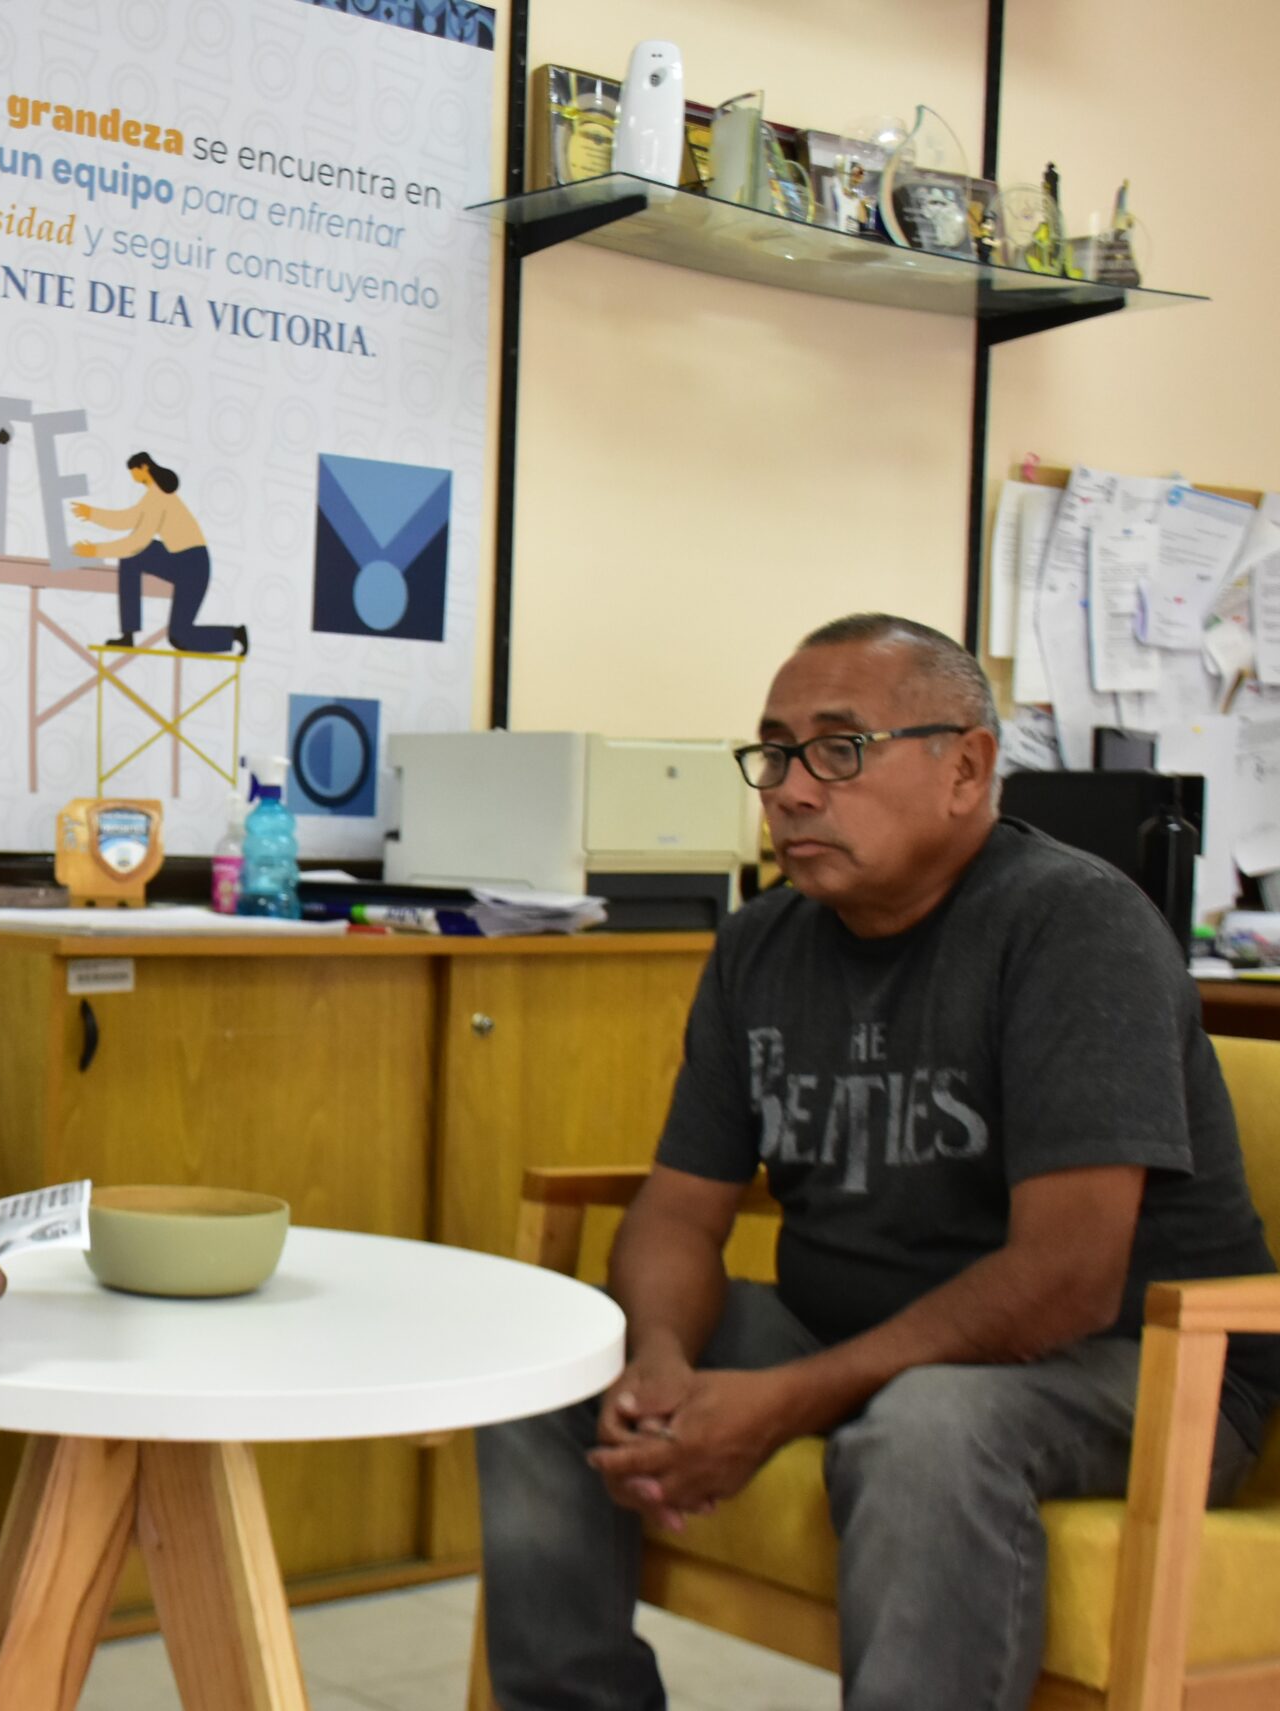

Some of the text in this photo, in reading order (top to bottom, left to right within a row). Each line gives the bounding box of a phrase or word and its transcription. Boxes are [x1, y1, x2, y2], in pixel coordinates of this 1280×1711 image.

[7, 94, 185, 156] grandeza
[192, 136, 228, 164] se
[238, 146, 397, 200] encuentra
[405, 181, 442, 209] en
[52, 157, 175, 210] equipo
[181, 183, 258, 221] para
[267, 201, 406, 249] enfrentar
[82, 224, 104, 257] y
[112, 229, 217, 271] seguir
[225, 250, 440, 310] construyendo
[88, 279, 137, 319] DE
[148, 290, 194, 328] LA
[207, 300, 378, 358] VICTORIA.
